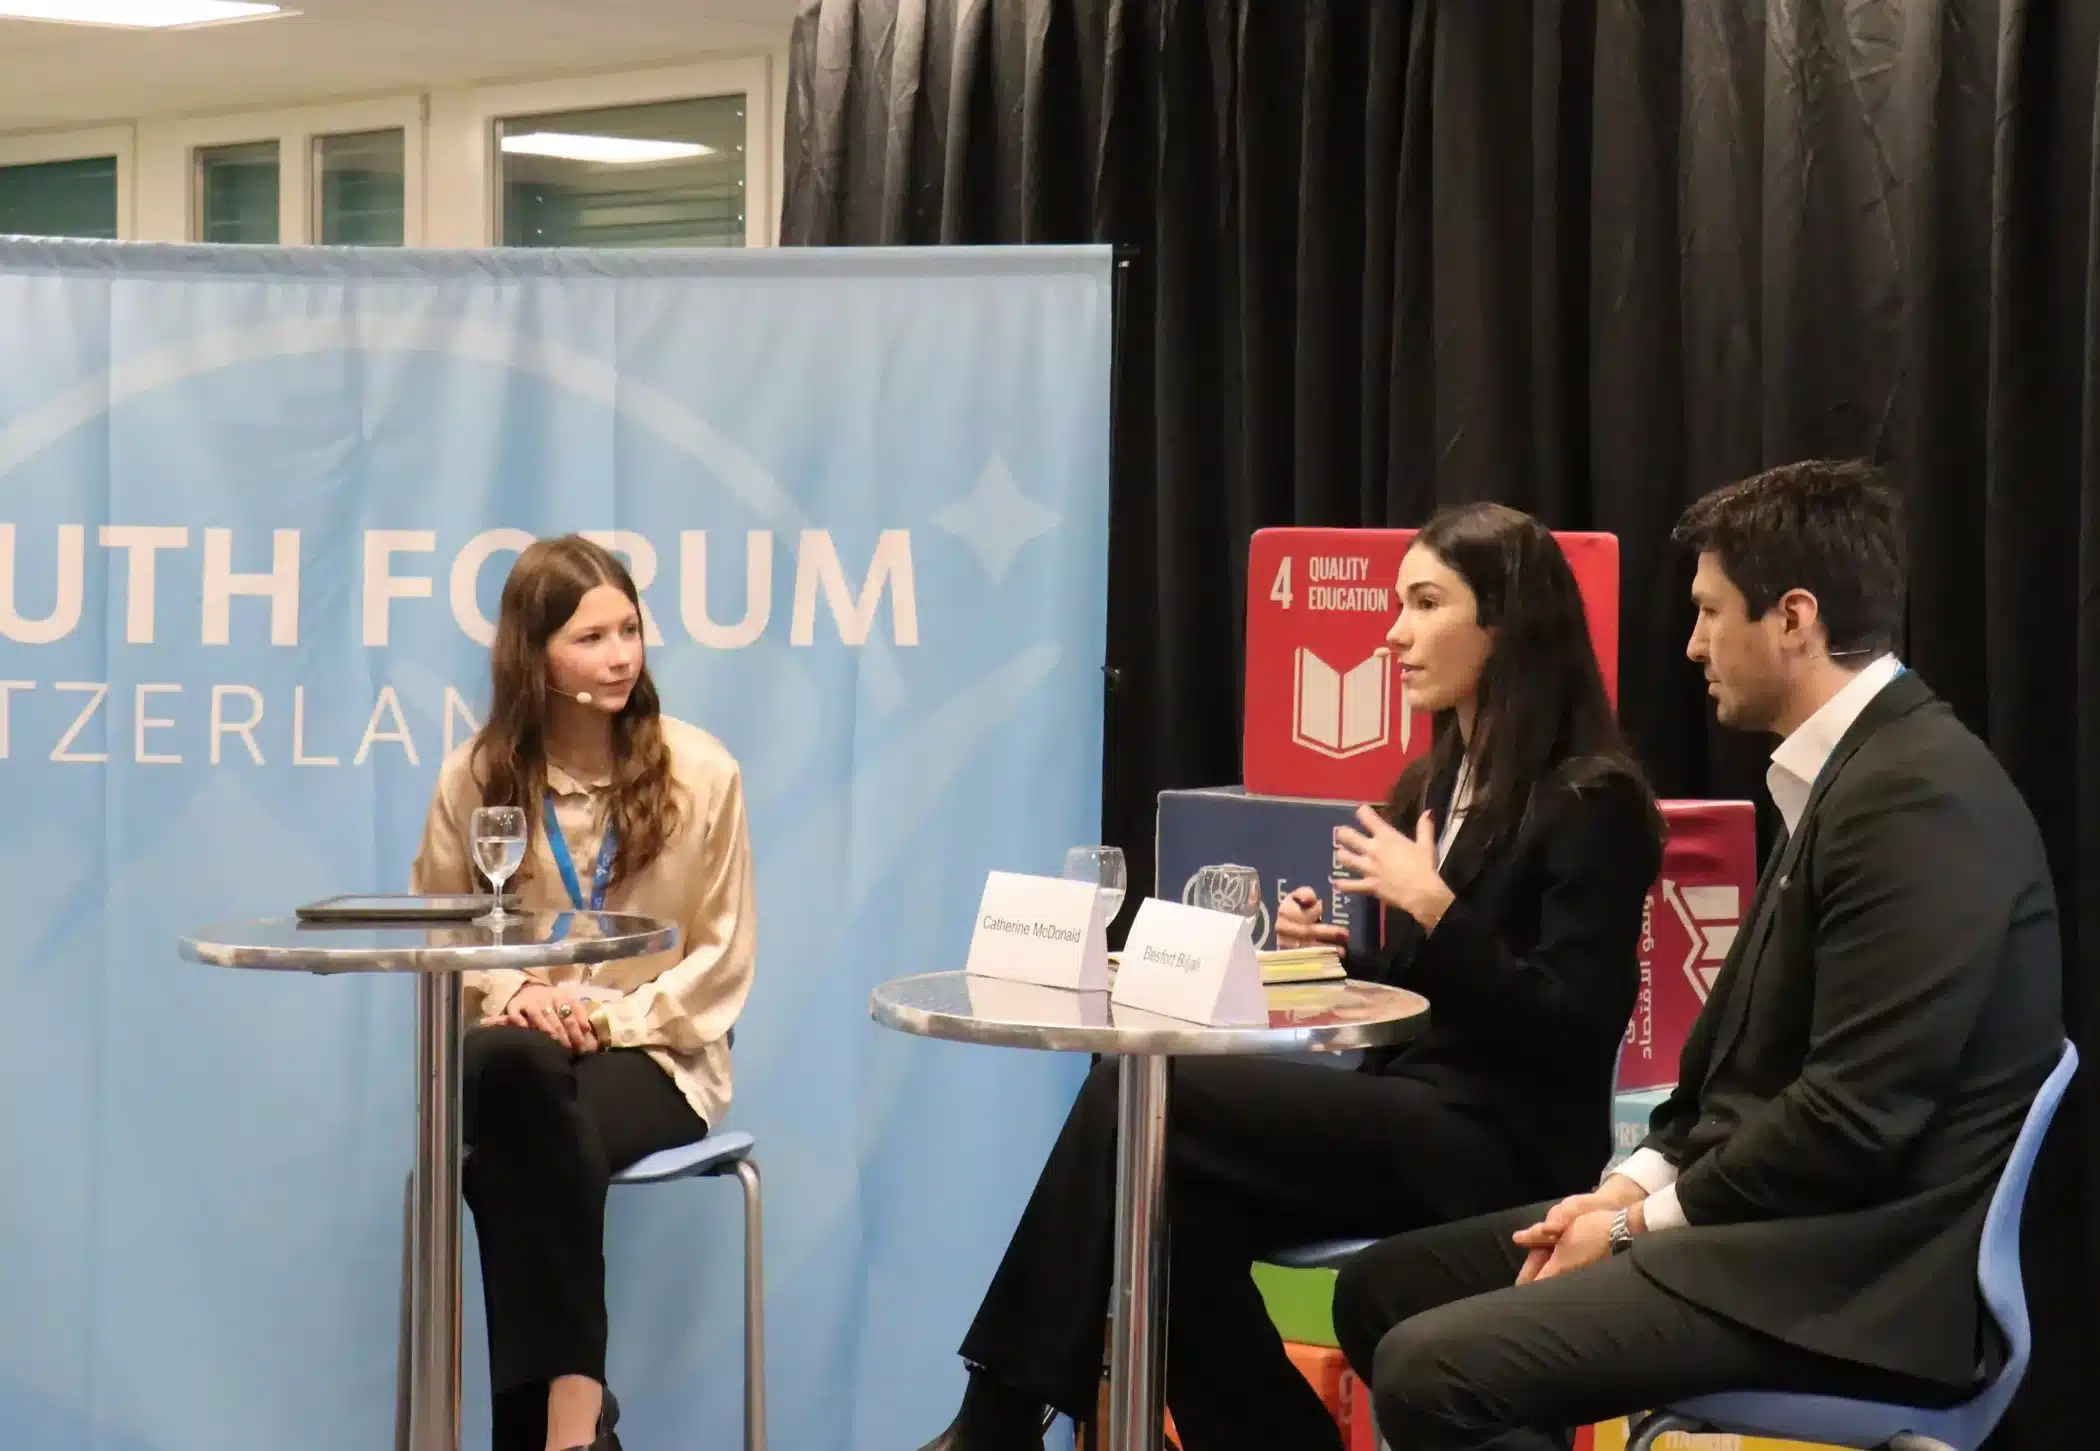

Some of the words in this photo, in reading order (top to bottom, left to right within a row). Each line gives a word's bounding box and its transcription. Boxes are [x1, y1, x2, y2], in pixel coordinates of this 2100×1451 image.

[1270, 556, 1293, 610] 4
[1309, 556, 1368, 582] QUALITY
[1308, 586, 1389, 612] EDUCATION
[983, 915, 1030, 936] Catherine
[1032, 922, 1081, 943] McDonald
